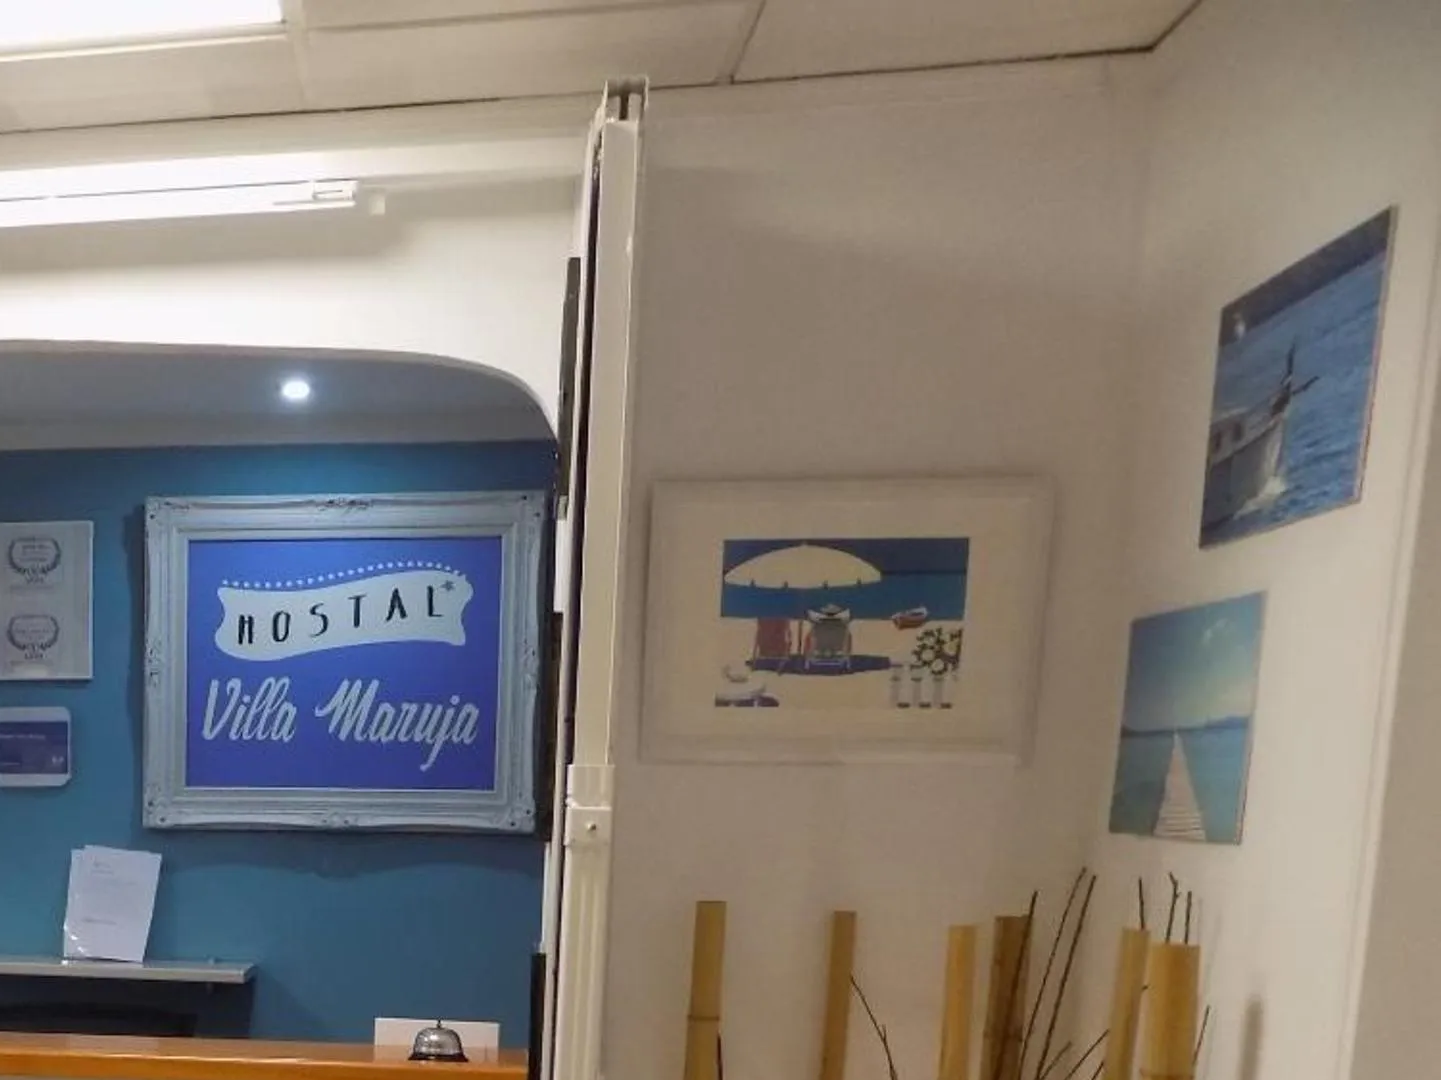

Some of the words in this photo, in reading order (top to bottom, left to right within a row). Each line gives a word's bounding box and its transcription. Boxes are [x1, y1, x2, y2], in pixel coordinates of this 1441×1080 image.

[237, 586, 444, 646] HOSTAL
[202, 676, 297, 742] Villa
[314, 679, 480, 771] Maruja
